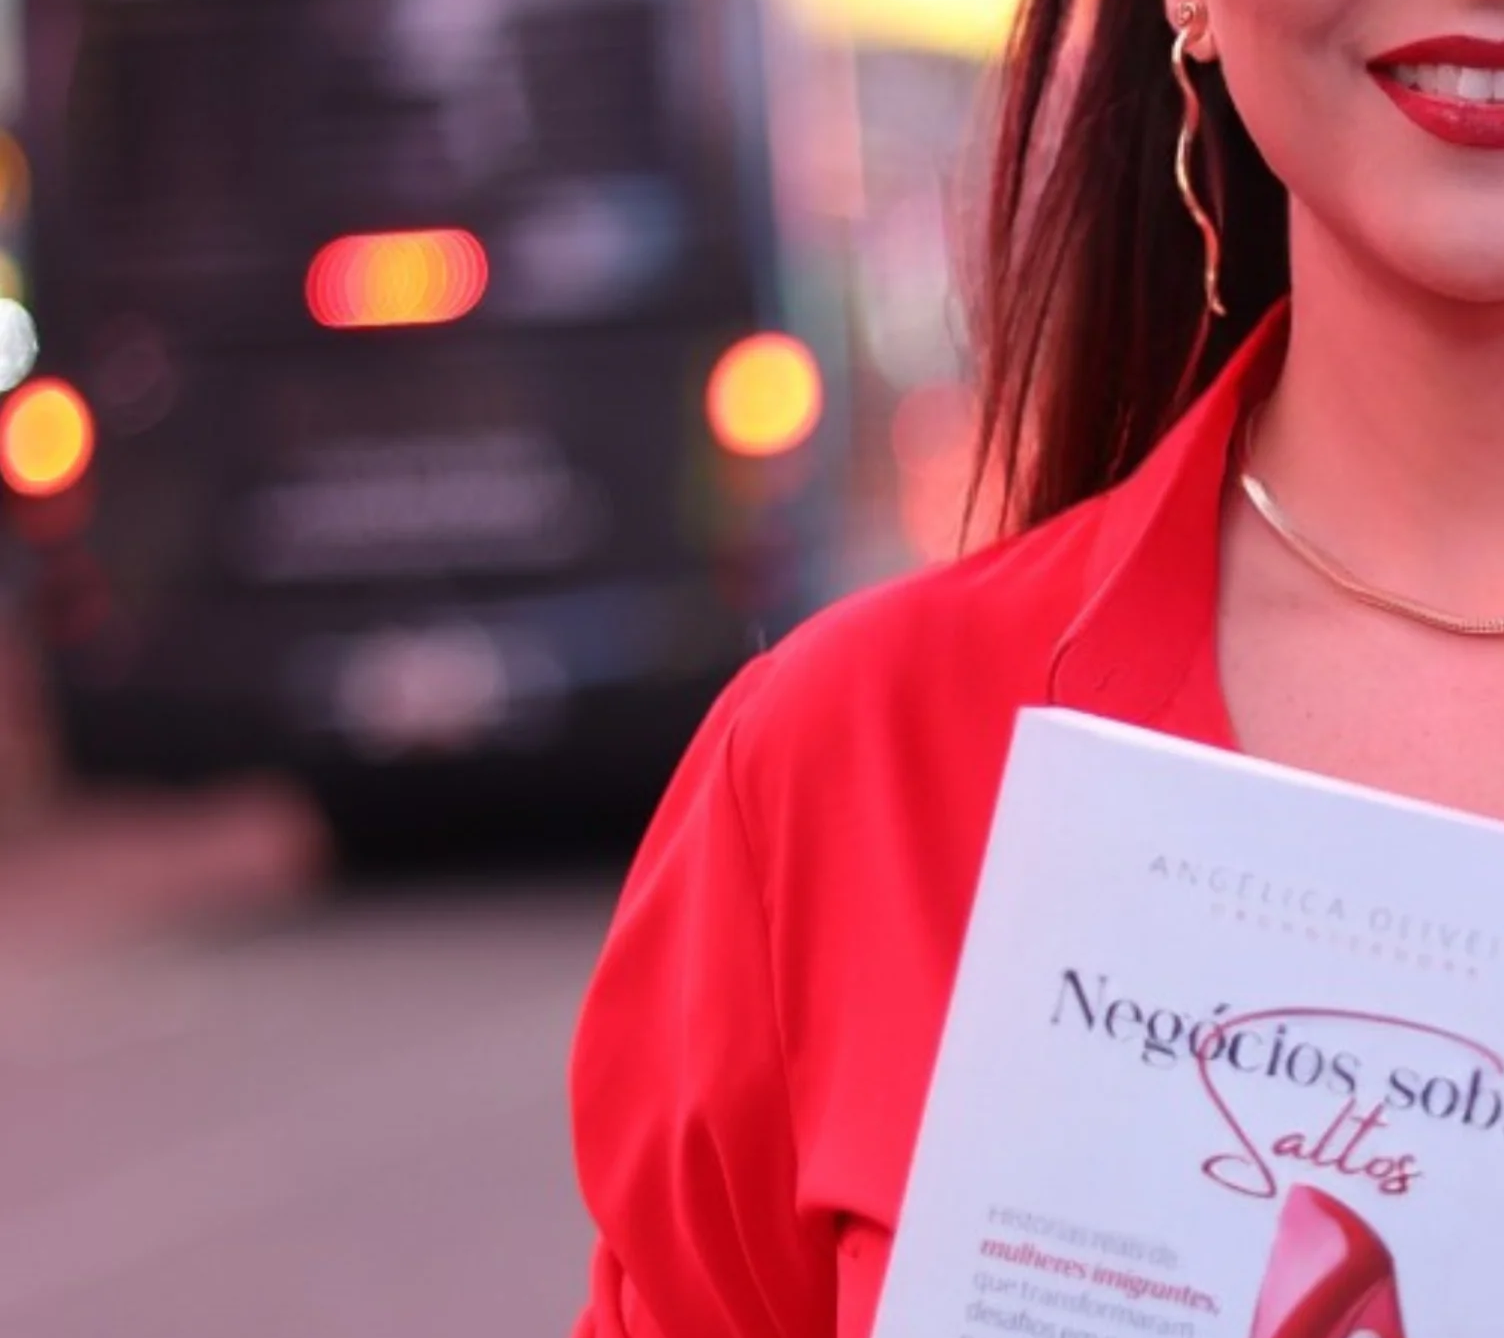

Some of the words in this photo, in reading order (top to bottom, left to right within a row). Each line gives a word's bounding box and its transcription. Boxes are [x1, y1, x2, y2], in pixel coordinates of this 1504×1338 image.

[1050, 966, 1360, 1095] Negócios
[1198, 1007, 1504, 1199] Saltos
[980, 1238, 1087, 1280] mulheres
